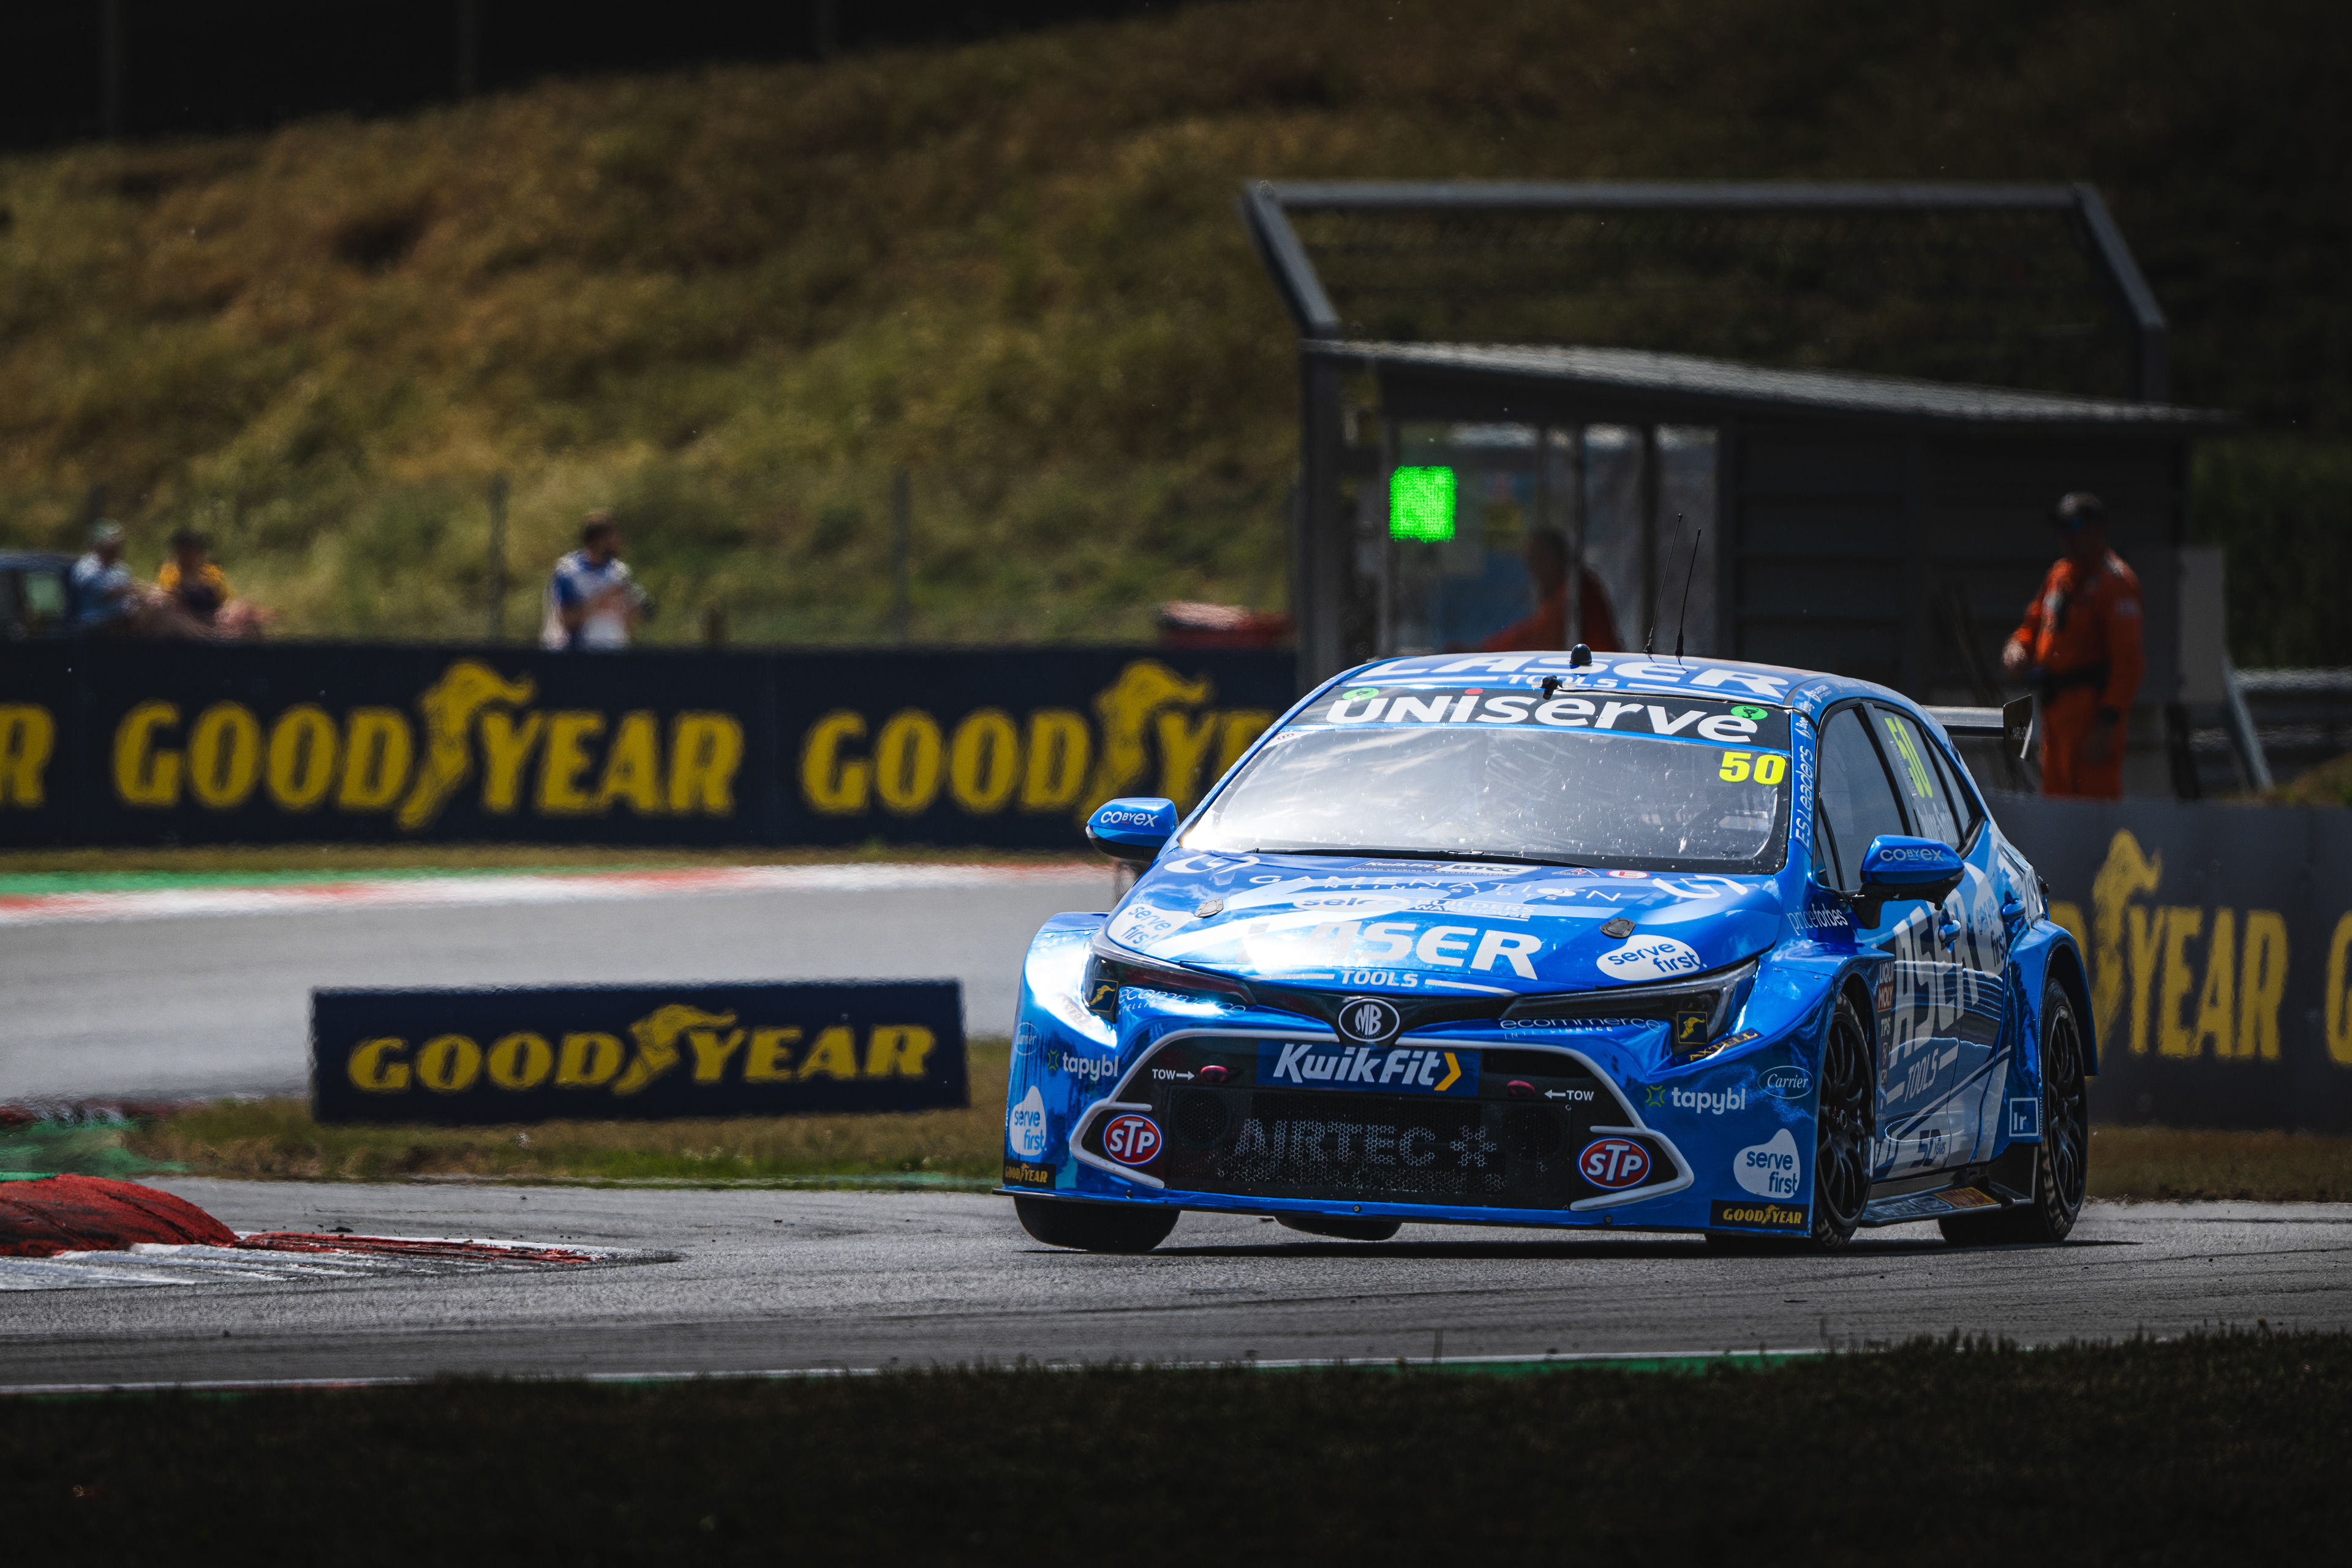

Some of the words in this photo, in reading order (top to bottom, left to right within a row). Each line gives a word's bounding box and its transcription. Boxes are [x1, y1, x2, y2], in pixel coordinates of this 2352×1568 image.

[1719, 752, 1786, 785] 50
[1884, 716, 1933, 799] 50
[1301, 896, 1398, 907] selco
[1414, 904, 1531, 919] WAREHOUSE
[1415, 899, 1539, 913] BUILDERS
[1128, 907, 1172, 931] serve
[1607, 943, 1676, 965] serve
[1340, 970, 1419, 988] TOOLS
[1889, 888, 1980, 1071] ASER
[1354, 1004, 1382, 1036] MB
[1500, 1016, 1662, 1033] ecommerce
[1689, 1031, 1758, 1061] AXTELL
[1062, 1052, 1119, 1082] tapybl
[1152, 1069, 1176, 1080] TOW
[1904, 1048, 1939, 1102] TOOLS
[1766, 1074, 1809, 1088] Carrier
[1566, 1090, 1594, 1101] TOW
[1671, 1087, 1746, 1115] tapybl
[1014, 1110, 1041, 1127] serve
[1109, 1120, 1156, 1158] STP
[1233, 1118, 1436, 1167] AIRTEC
[1586, 1144, 1643, 1182] STP
[1746, 1150, 1793, 1170] serve
